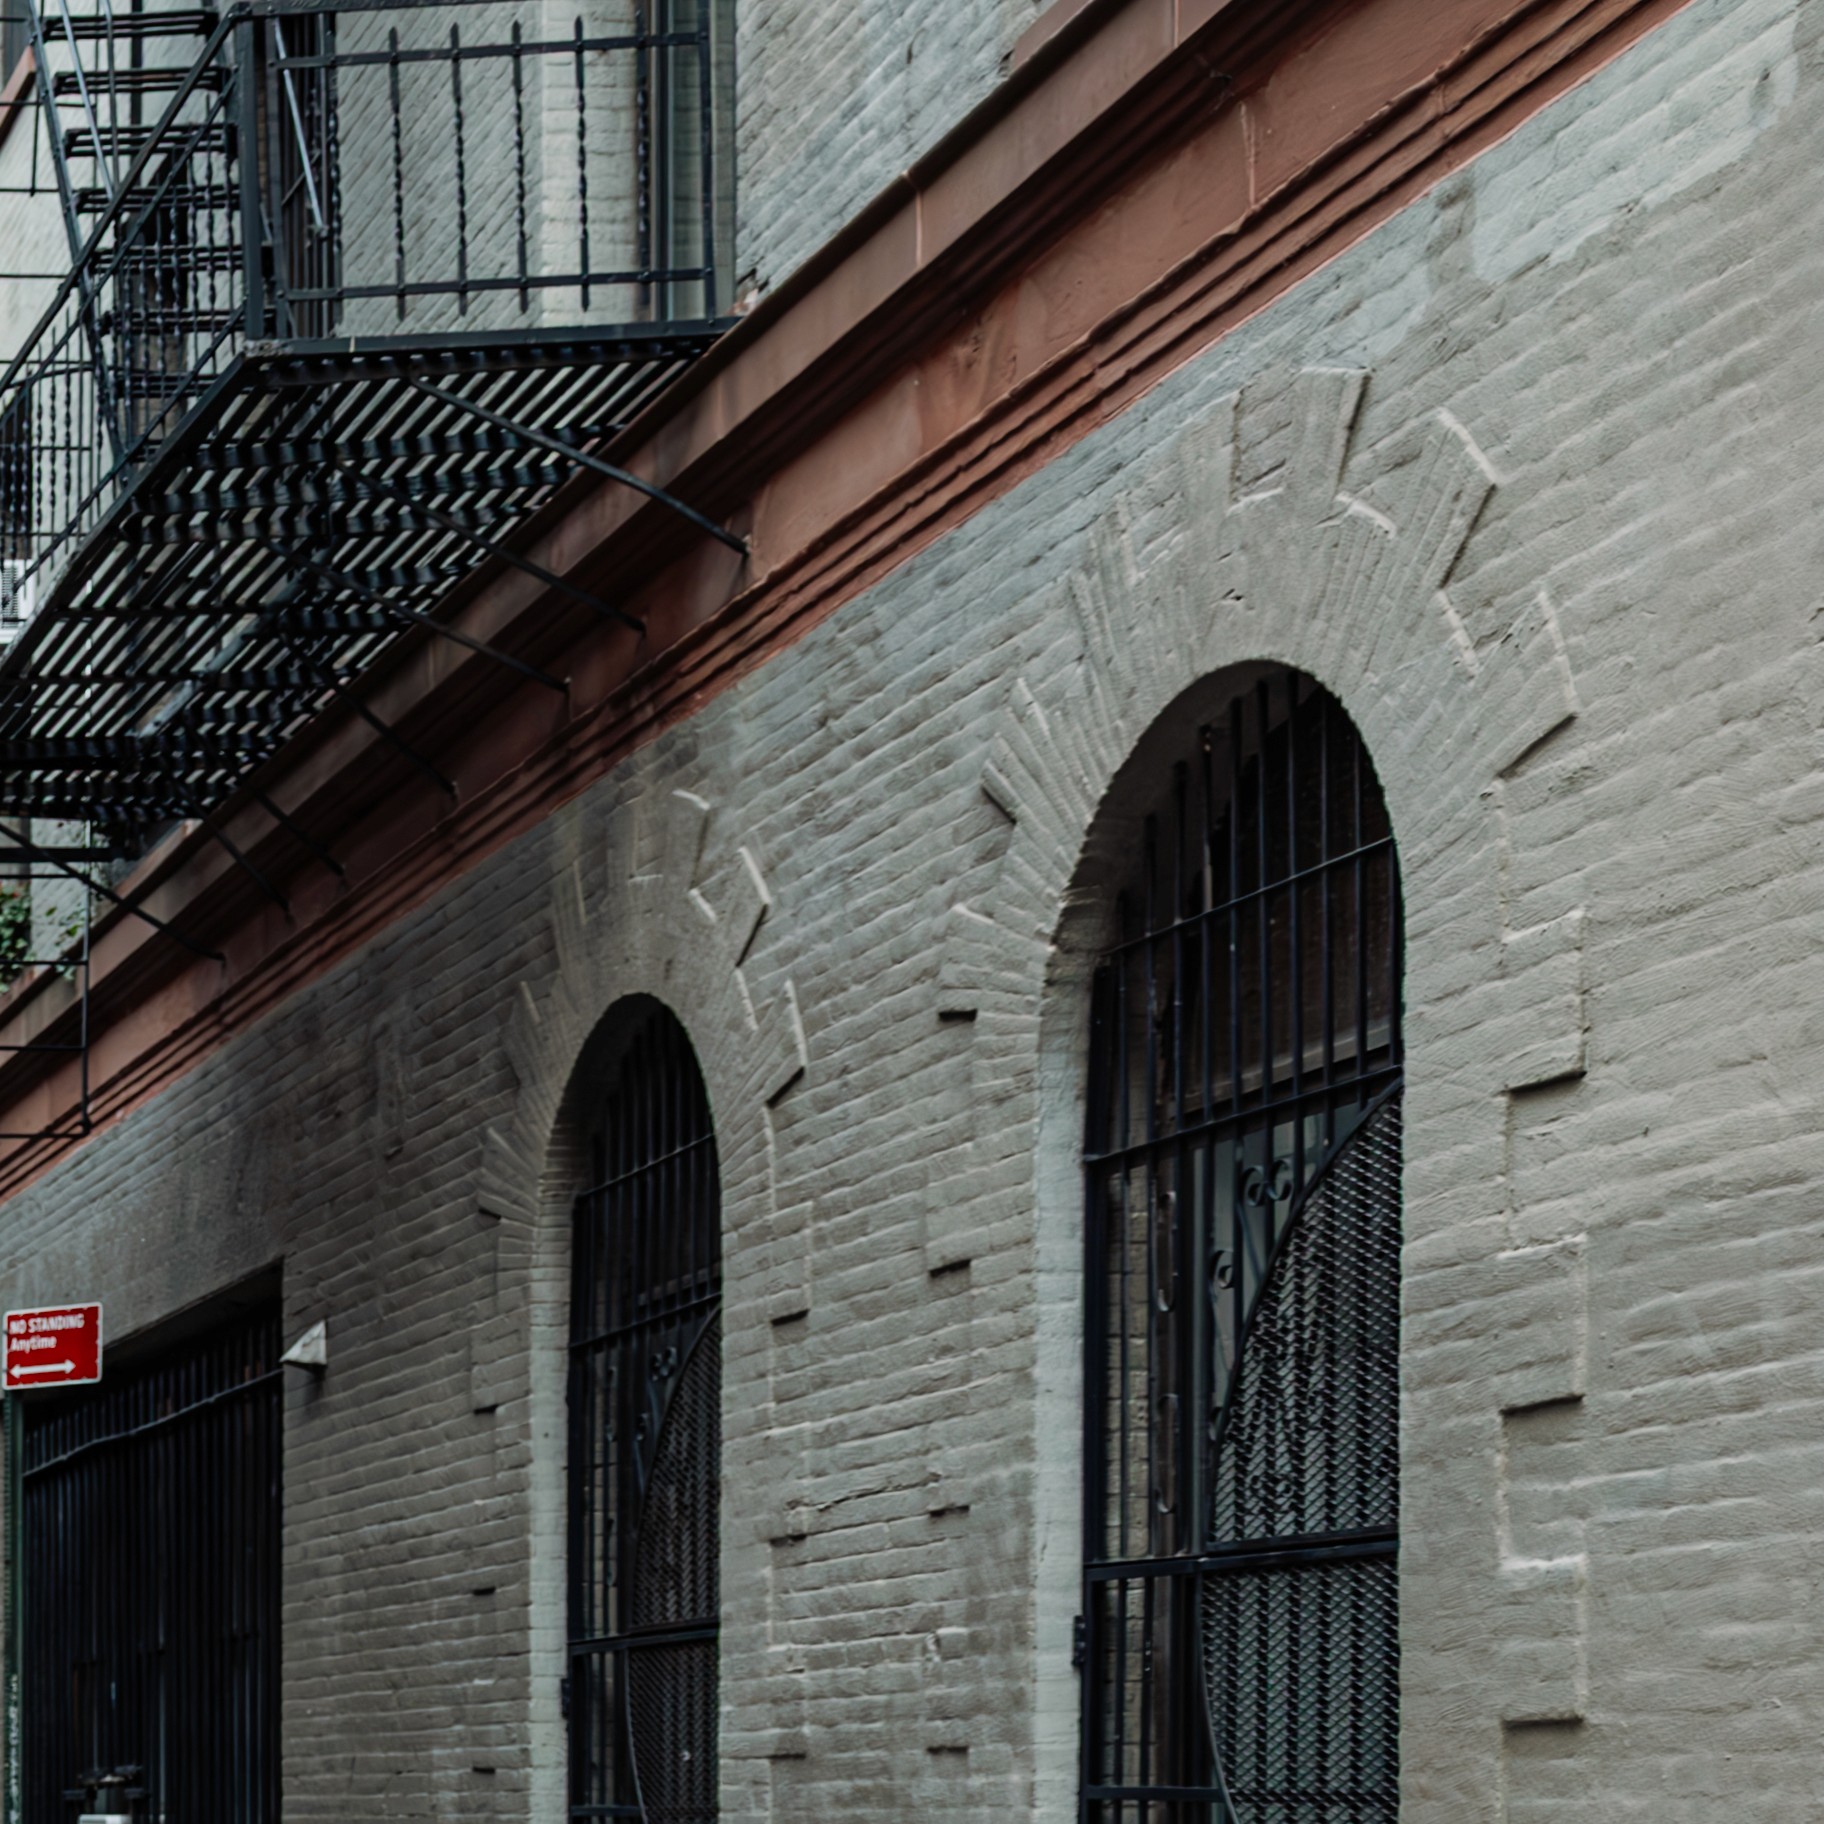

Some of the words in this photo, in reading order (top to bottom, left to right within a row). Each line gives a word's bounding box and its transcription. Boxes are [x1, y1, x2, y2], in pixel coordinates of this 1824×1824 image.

[9, 1319, 27, 1334] NO
[28, 1313, 85, 1333] STANDING
[10, 1335, 57, 1354] Anytime
